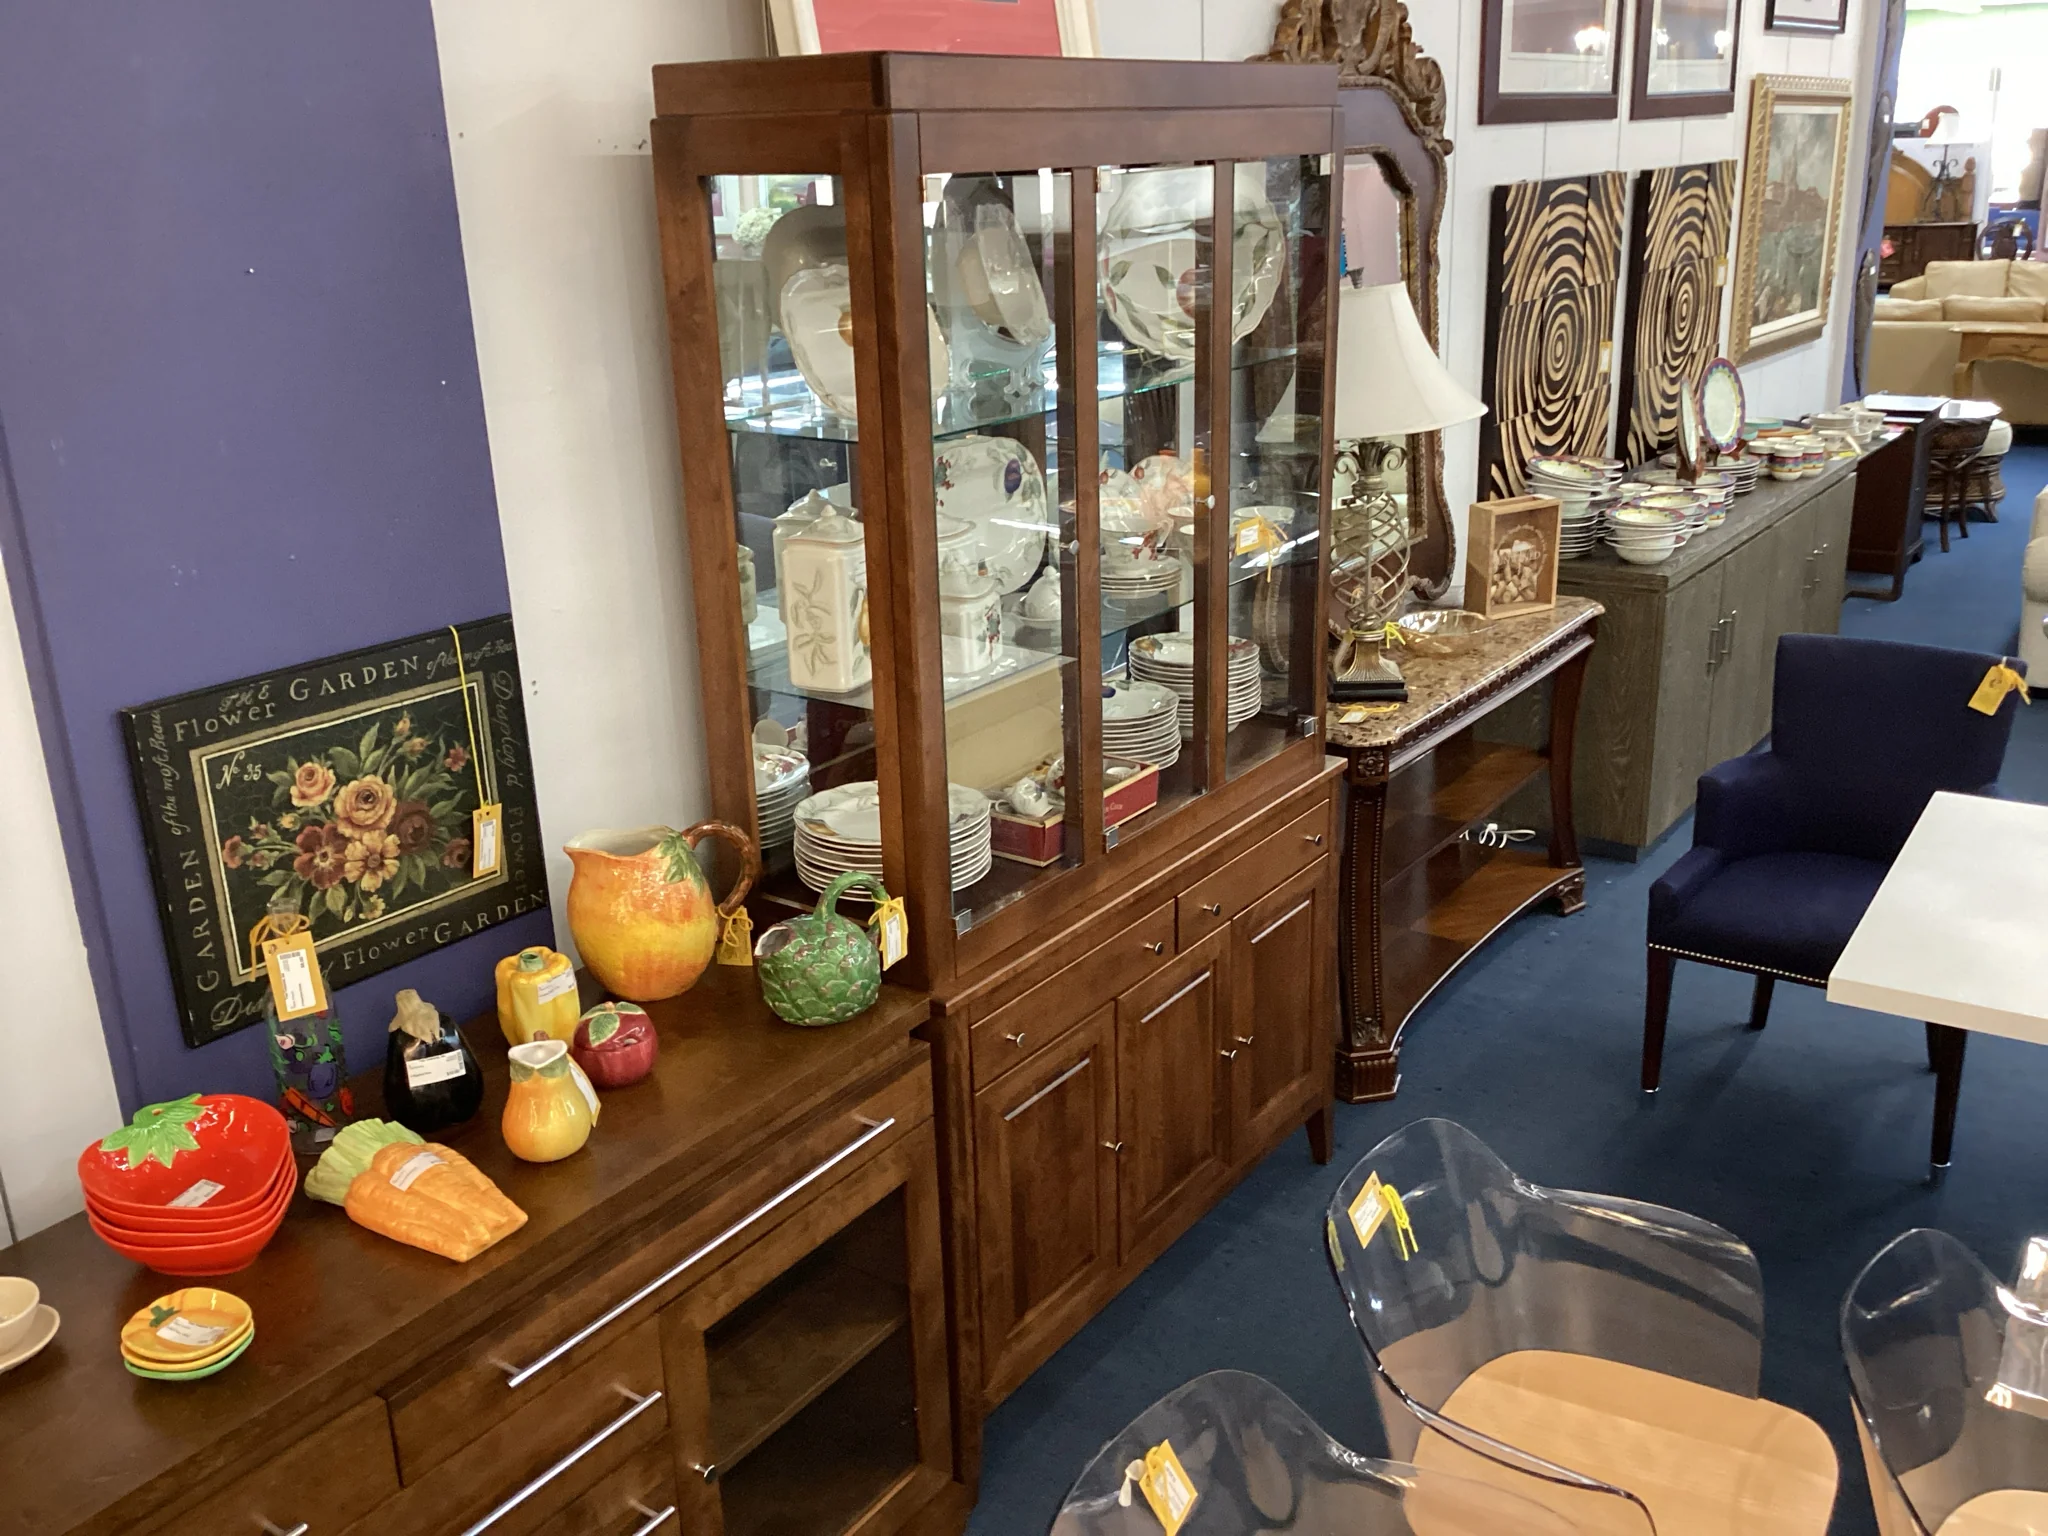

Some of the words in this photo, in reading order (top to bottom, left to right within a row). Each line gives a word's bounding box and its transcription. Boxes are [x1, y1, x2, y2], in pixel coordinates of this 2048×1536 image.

[174, 702, 276, 742] Flower
[289, 656, 419, 701] GARDEN
[243, 763, 262, 782] 35
[179, 849, 220, 993] GARDEN
[342, 926, 430, 971] Flower
[434, 889, 546, 945] GARDEN
